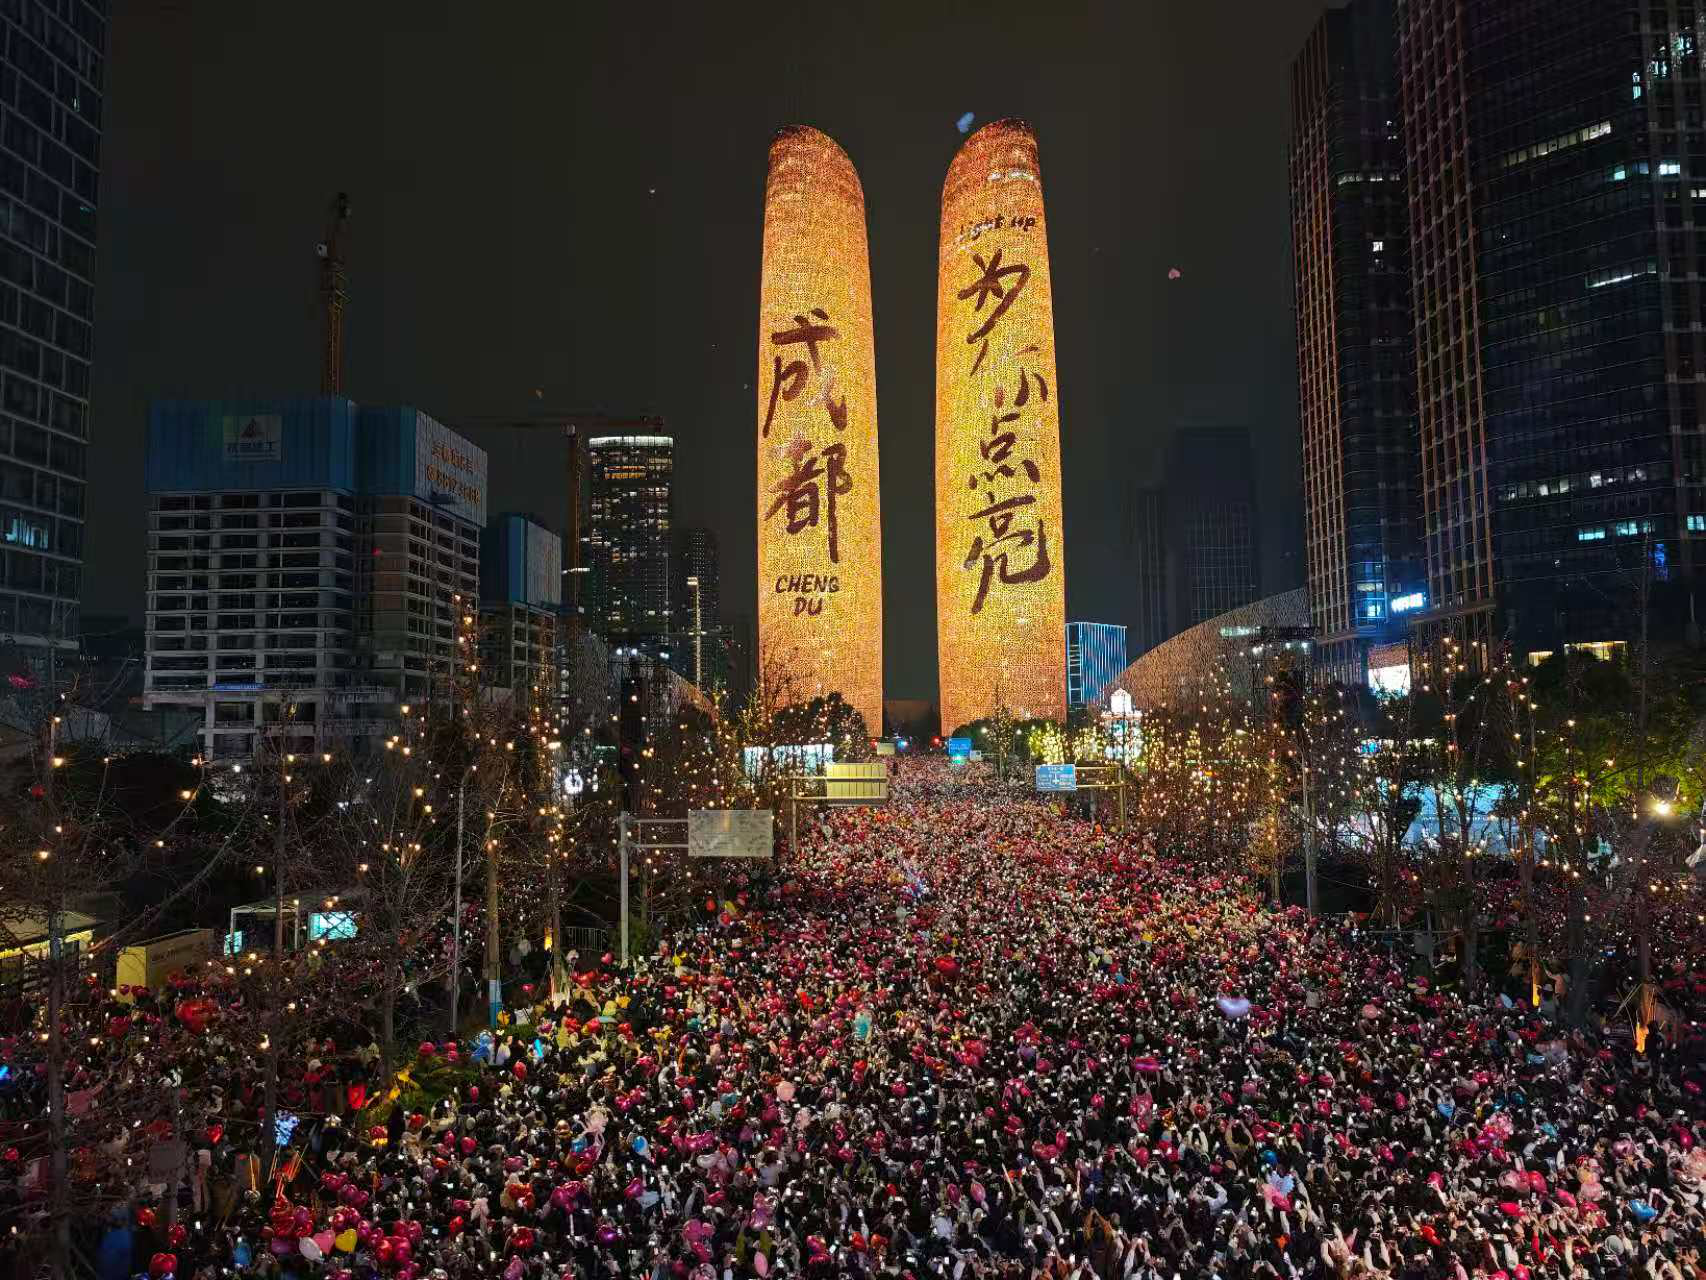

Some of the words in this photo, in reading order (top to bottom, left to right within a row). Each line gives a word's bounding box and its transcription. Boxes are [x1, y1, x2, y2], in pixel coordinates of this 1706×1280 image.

[762, 308, 853, 564] 成都
[775, 573, 840, 594] CHENG
[794, 597, 823, 618] DU
